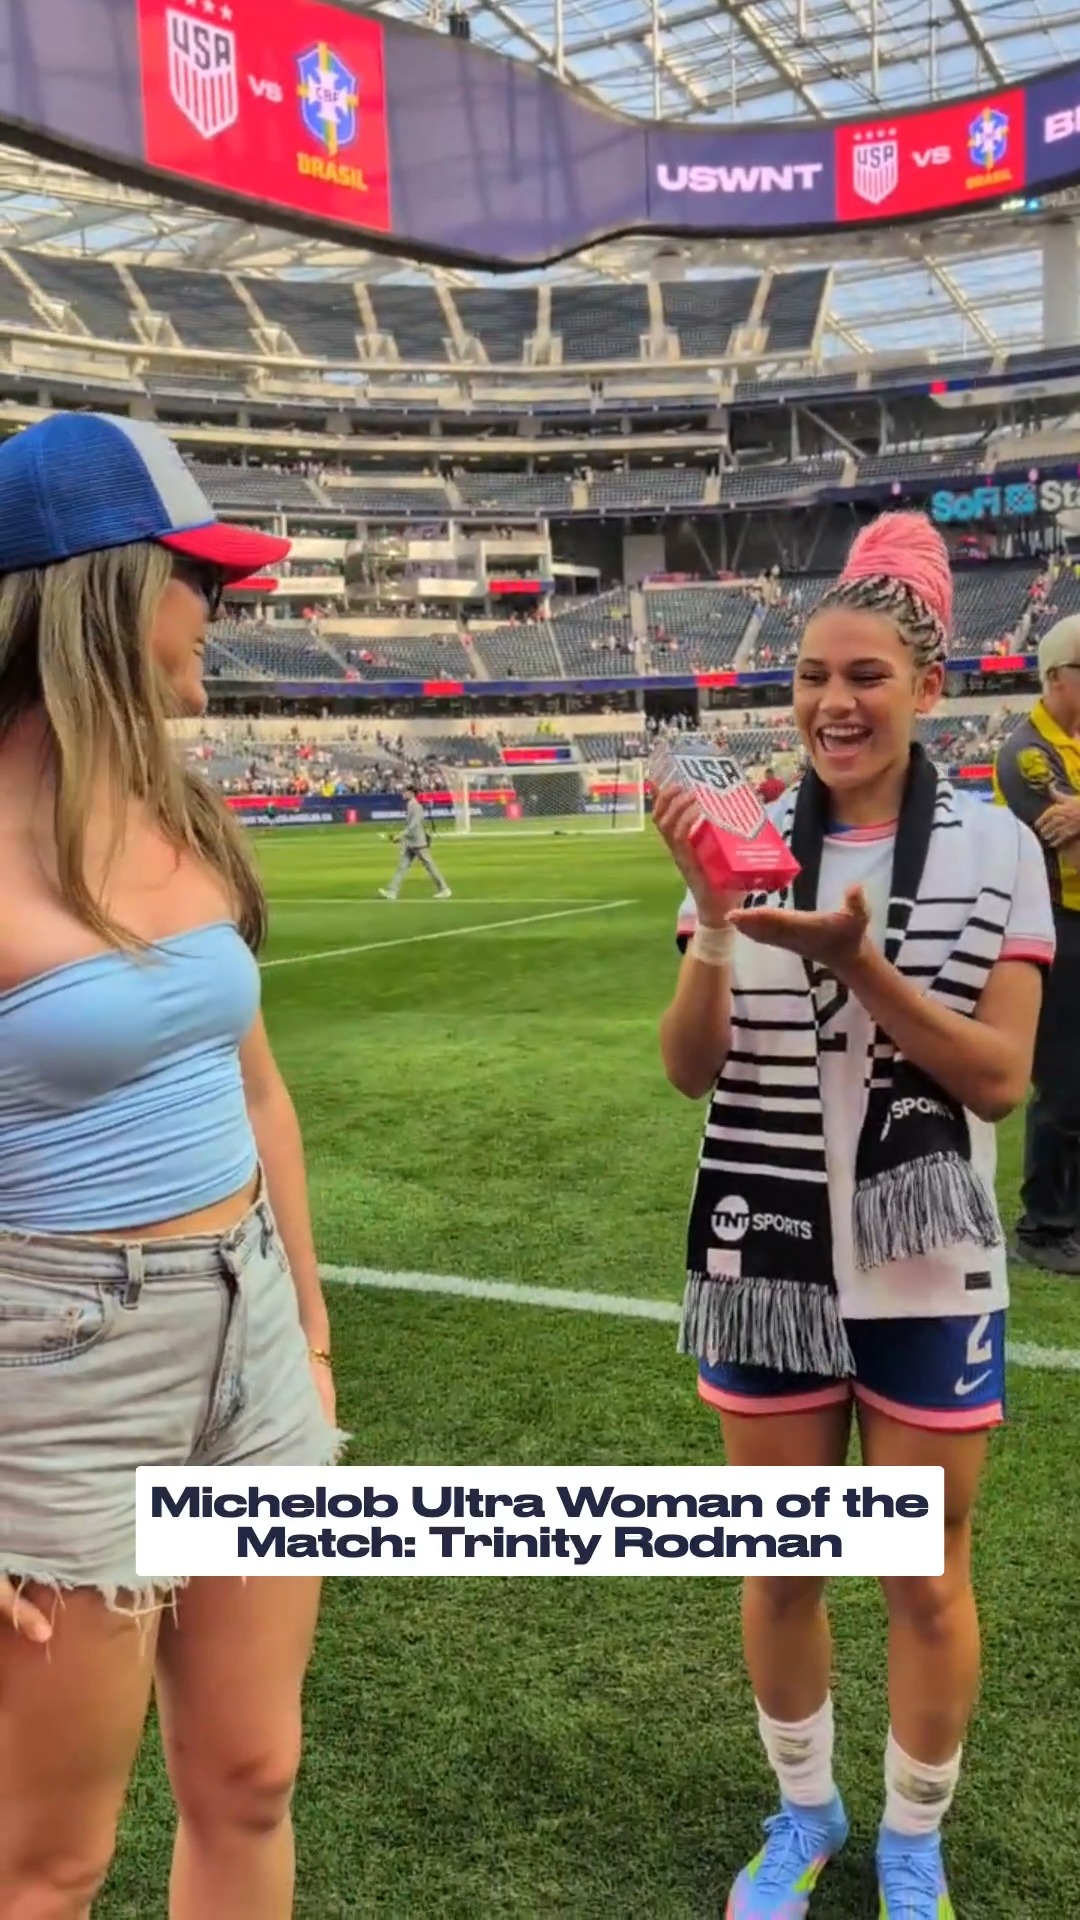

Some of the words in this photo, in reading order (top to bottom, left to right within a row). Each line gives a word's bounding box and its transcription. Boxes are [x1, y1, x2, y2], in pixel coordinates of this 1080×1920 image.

[172, 15, 231, 71] USA
[1044, 104, 1080, 143] B
[297, 151, 368, 191] BRASIL
[856, 144, 895, 169] USA
[656, 163, 822, 193] USWNT
[932, 486, 1001, 522] SoFi
[1040, 479, 1080, 512] St
[680, 758, 741, 790] USA
[811, 967, 849, 1052] 2
[890, 1096, 955, 1120] SPOR
[752, 1212, 813, 1240] SPORTS
[966, 1314, 993, 1365] 2
